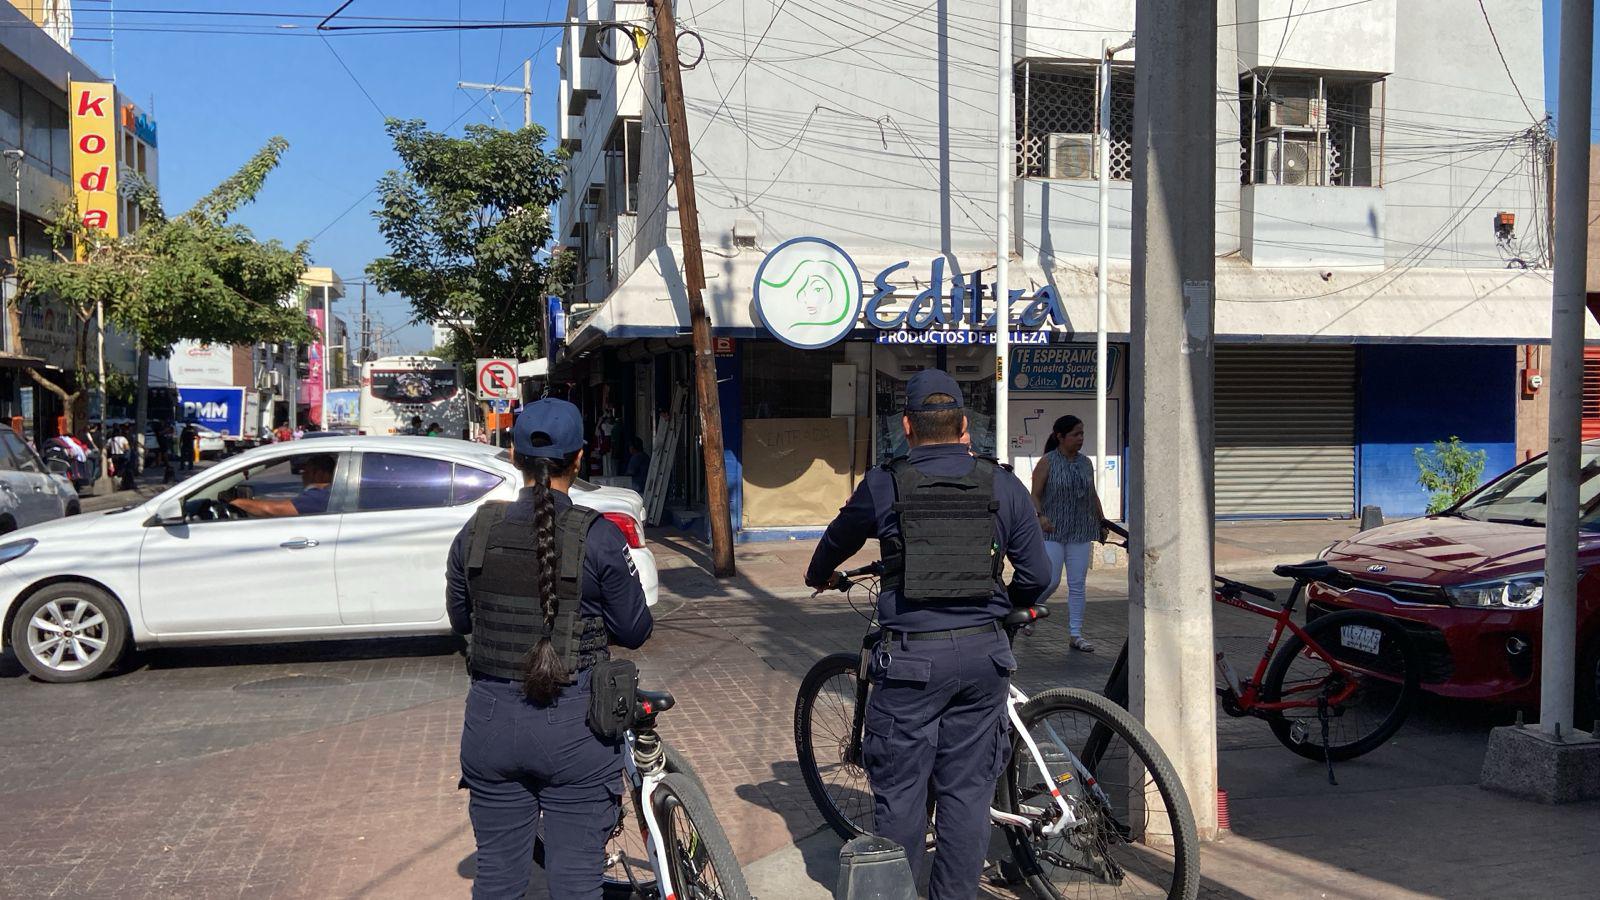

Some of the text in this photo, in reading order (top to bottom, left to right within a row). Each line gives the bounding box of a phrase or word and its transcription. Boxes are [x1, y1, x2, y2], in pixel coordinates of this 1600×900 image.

[864, 256, 1067, 330] Editza
[879, 331, 1048, 344] PRODUCTOS DE BLLEZA
[1017, 349, 1109, 363] TE ESPERAMO
[1021, 364, 1031, 373] En
[1033, 364, 1064, 373] nuestra
[491, 370, 505, 388] E
[184, 401, 228, 419] PMM
